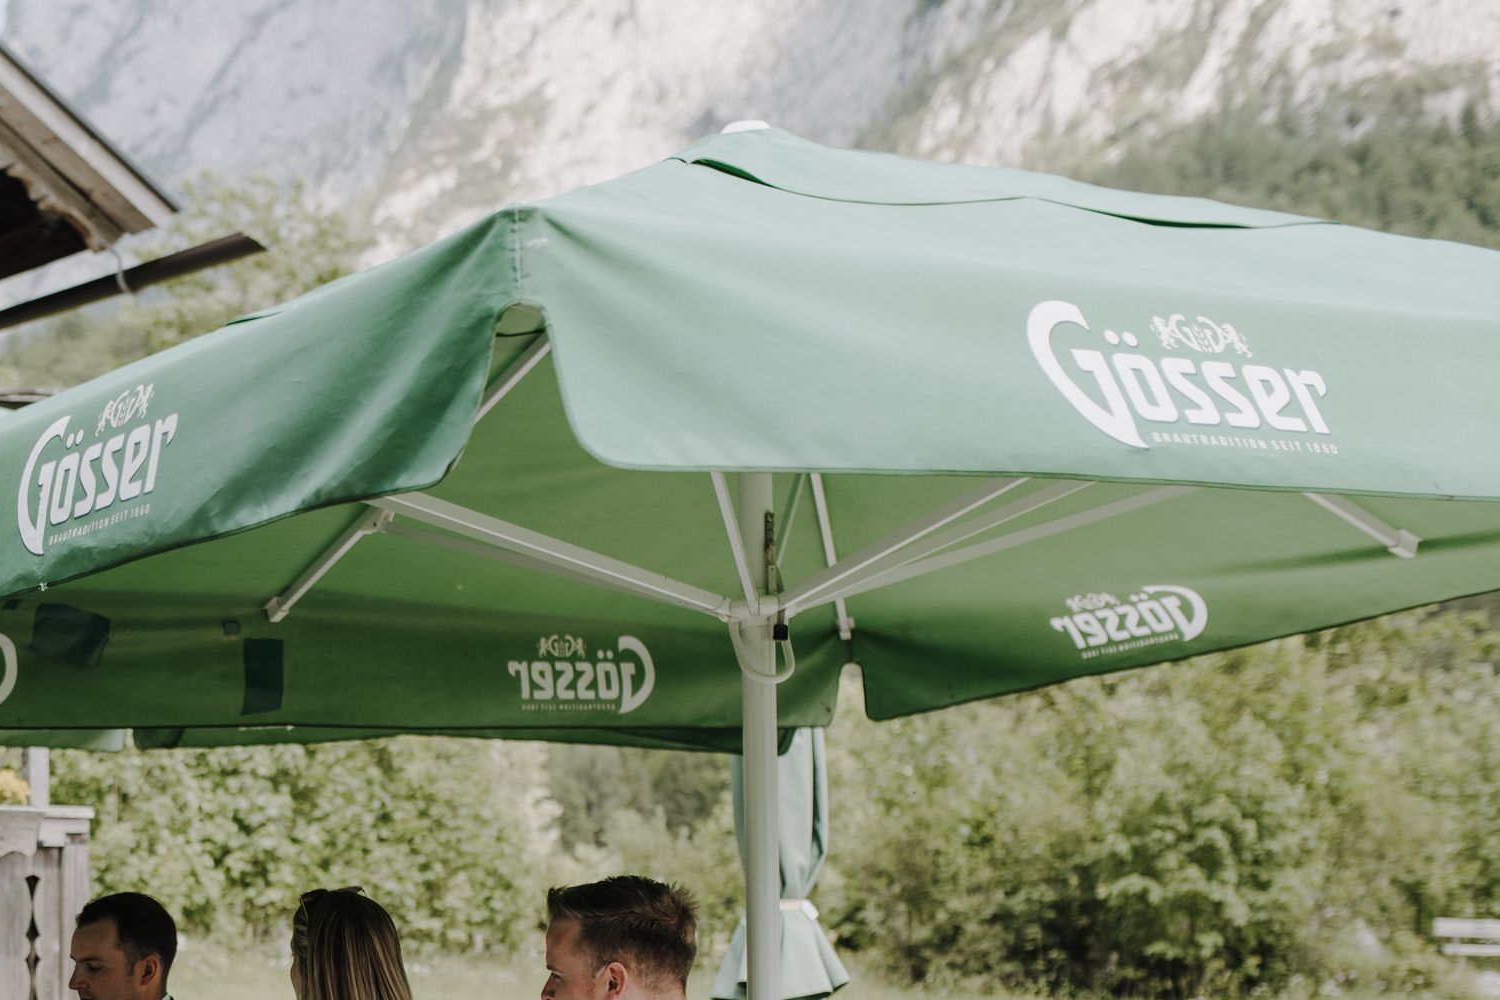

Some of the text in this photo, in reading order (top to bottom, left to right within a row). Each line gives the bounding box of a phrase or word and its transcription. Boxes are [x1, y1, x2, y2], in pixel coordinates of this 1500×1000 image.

[1026, 300, 1331, 450] Gösser
[17, 412, 179, 555] Gösser
[1151, 431, 1339, 455] BRAUTRADITION SEIT 1860
[48, 519, 110, 546] BRAUTRADITION
